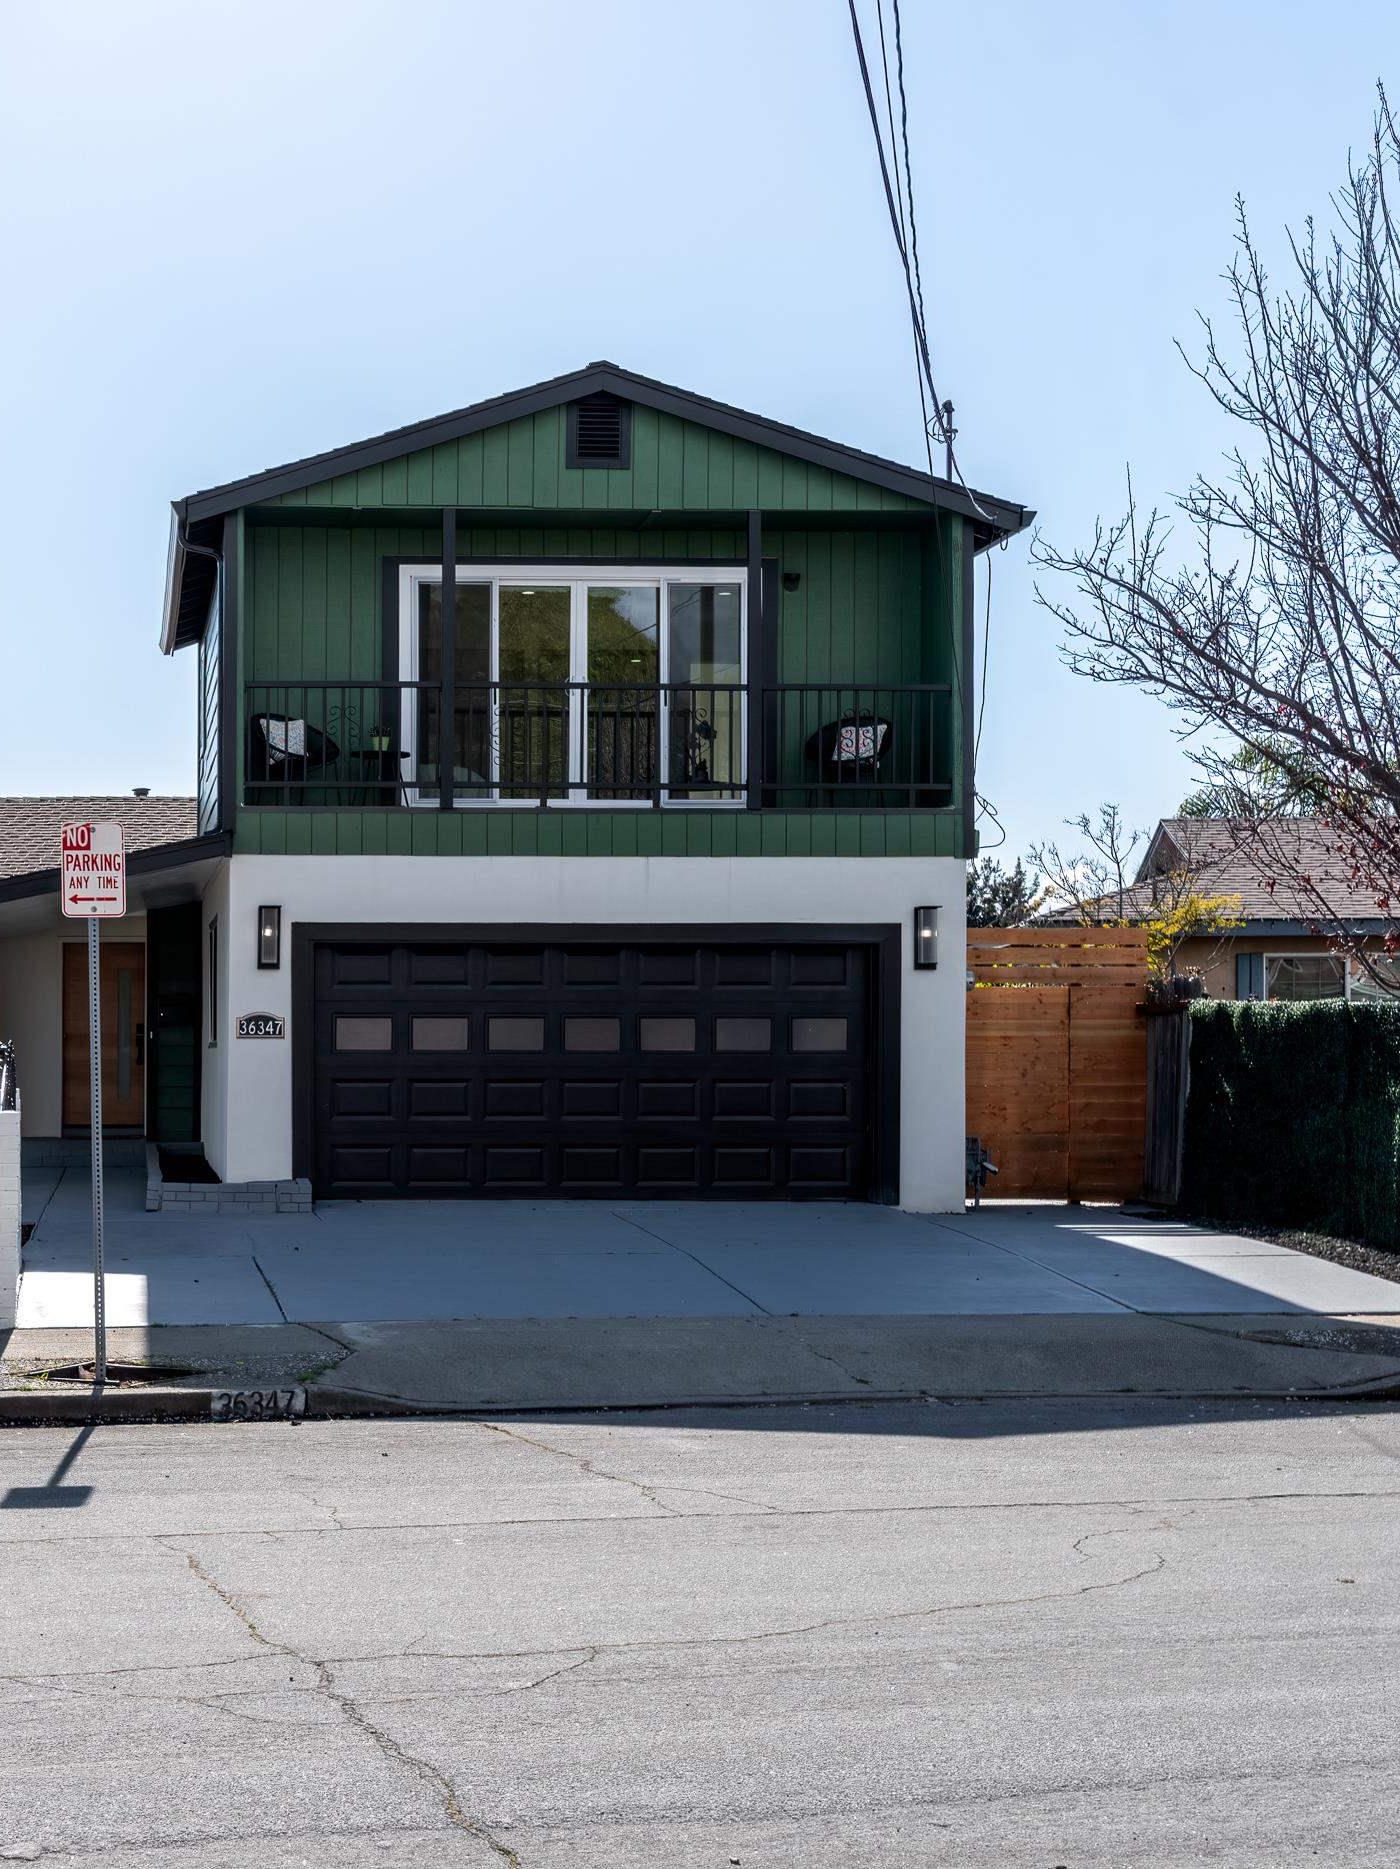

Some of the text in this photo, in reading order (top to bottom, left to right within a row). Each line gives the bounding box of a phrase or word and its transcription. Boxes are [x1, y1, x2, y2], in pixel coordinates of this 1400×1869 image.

[66, 826, 89, 848] NO
[65, 853, 121, 872] PARKING
[69, 875, 119, 889] ANY TIME
[239, 1020, 282, 1035] 36347
[219, 1390, 296, 1418] 36347
